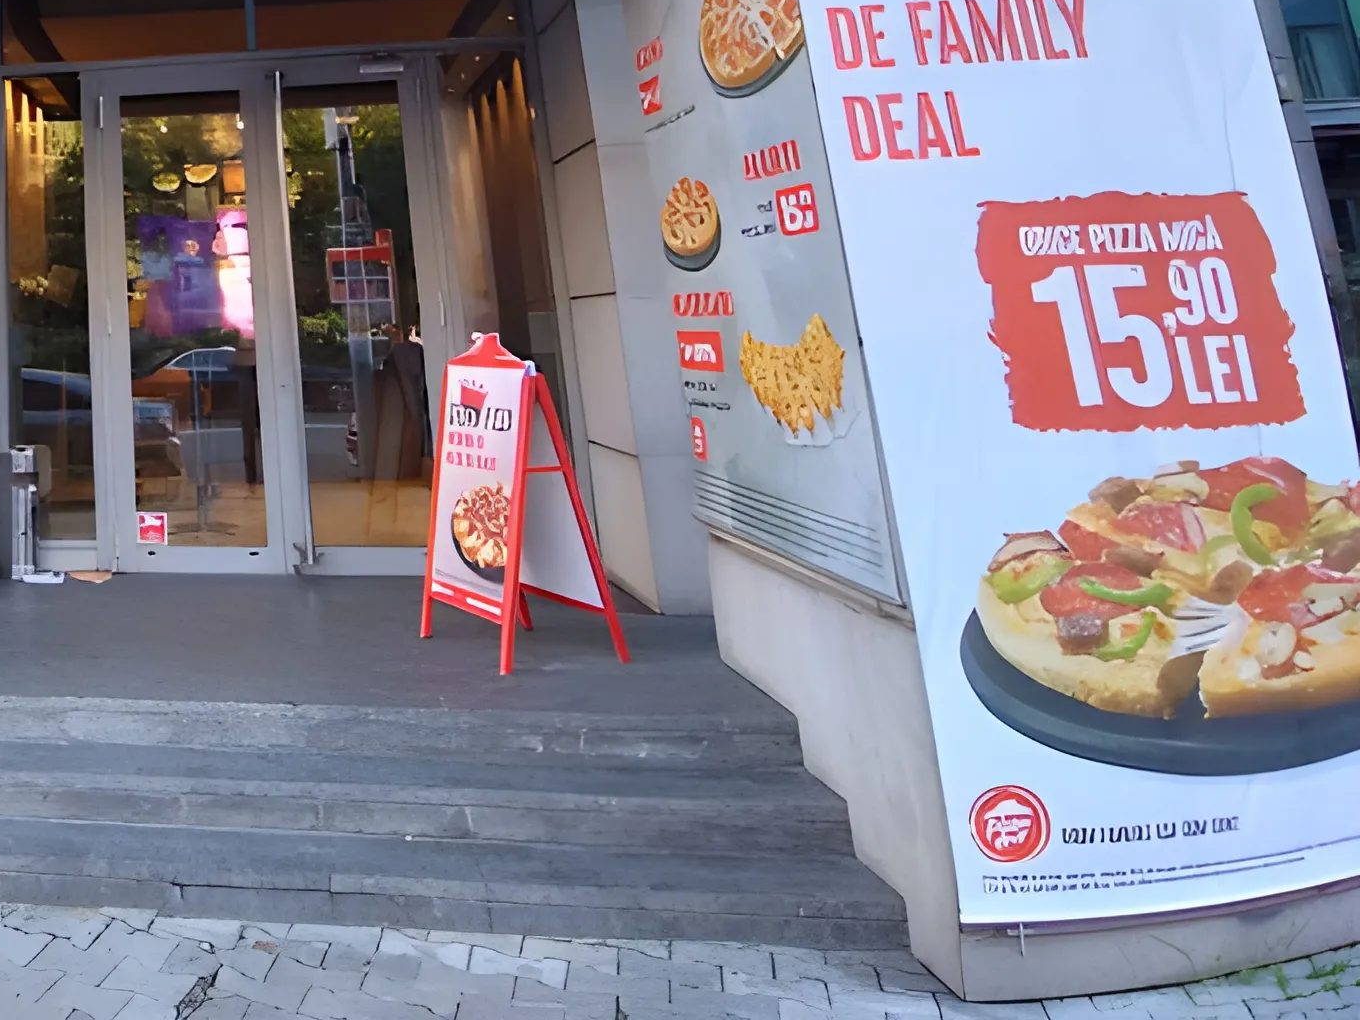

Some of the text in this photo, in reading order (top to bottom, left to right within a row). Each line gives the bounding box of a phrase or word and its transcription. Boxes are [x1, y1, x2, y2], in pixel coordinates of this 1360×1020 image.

[826, 4, 896, 70] DE
[843, 90, 981, 162] DEAL
[1175, 335, 1259, 404] LEI
